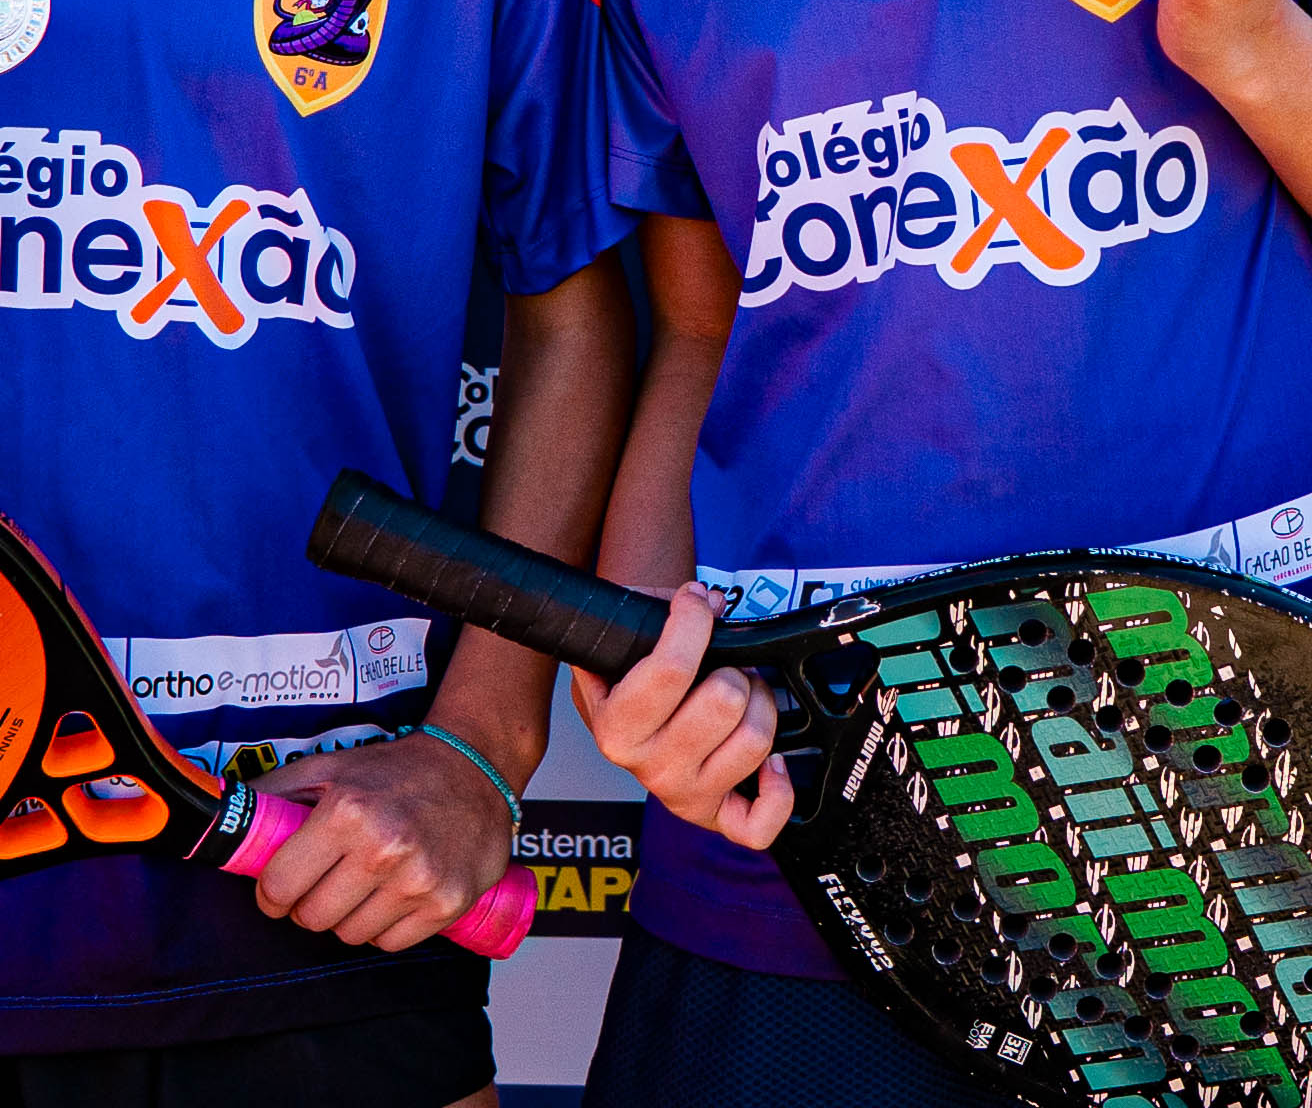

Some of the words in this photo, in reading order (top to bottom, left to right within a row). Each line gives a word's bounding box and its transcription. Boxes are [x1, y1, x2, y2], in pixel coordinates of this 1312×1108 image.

[764, 108, 931, 191] olégio
[382, 652, 425, 675] BELLE
[132, 670, 214, 698] ortho
[240, 695, 269, 703] make
[276, 692, 302, 702] your
[309, 692, 339, 700] move
[842, 720, 885, 803] mormaii
[512, 828, 632, 858] istema
[974, 1021, 996, 1051] EVA
